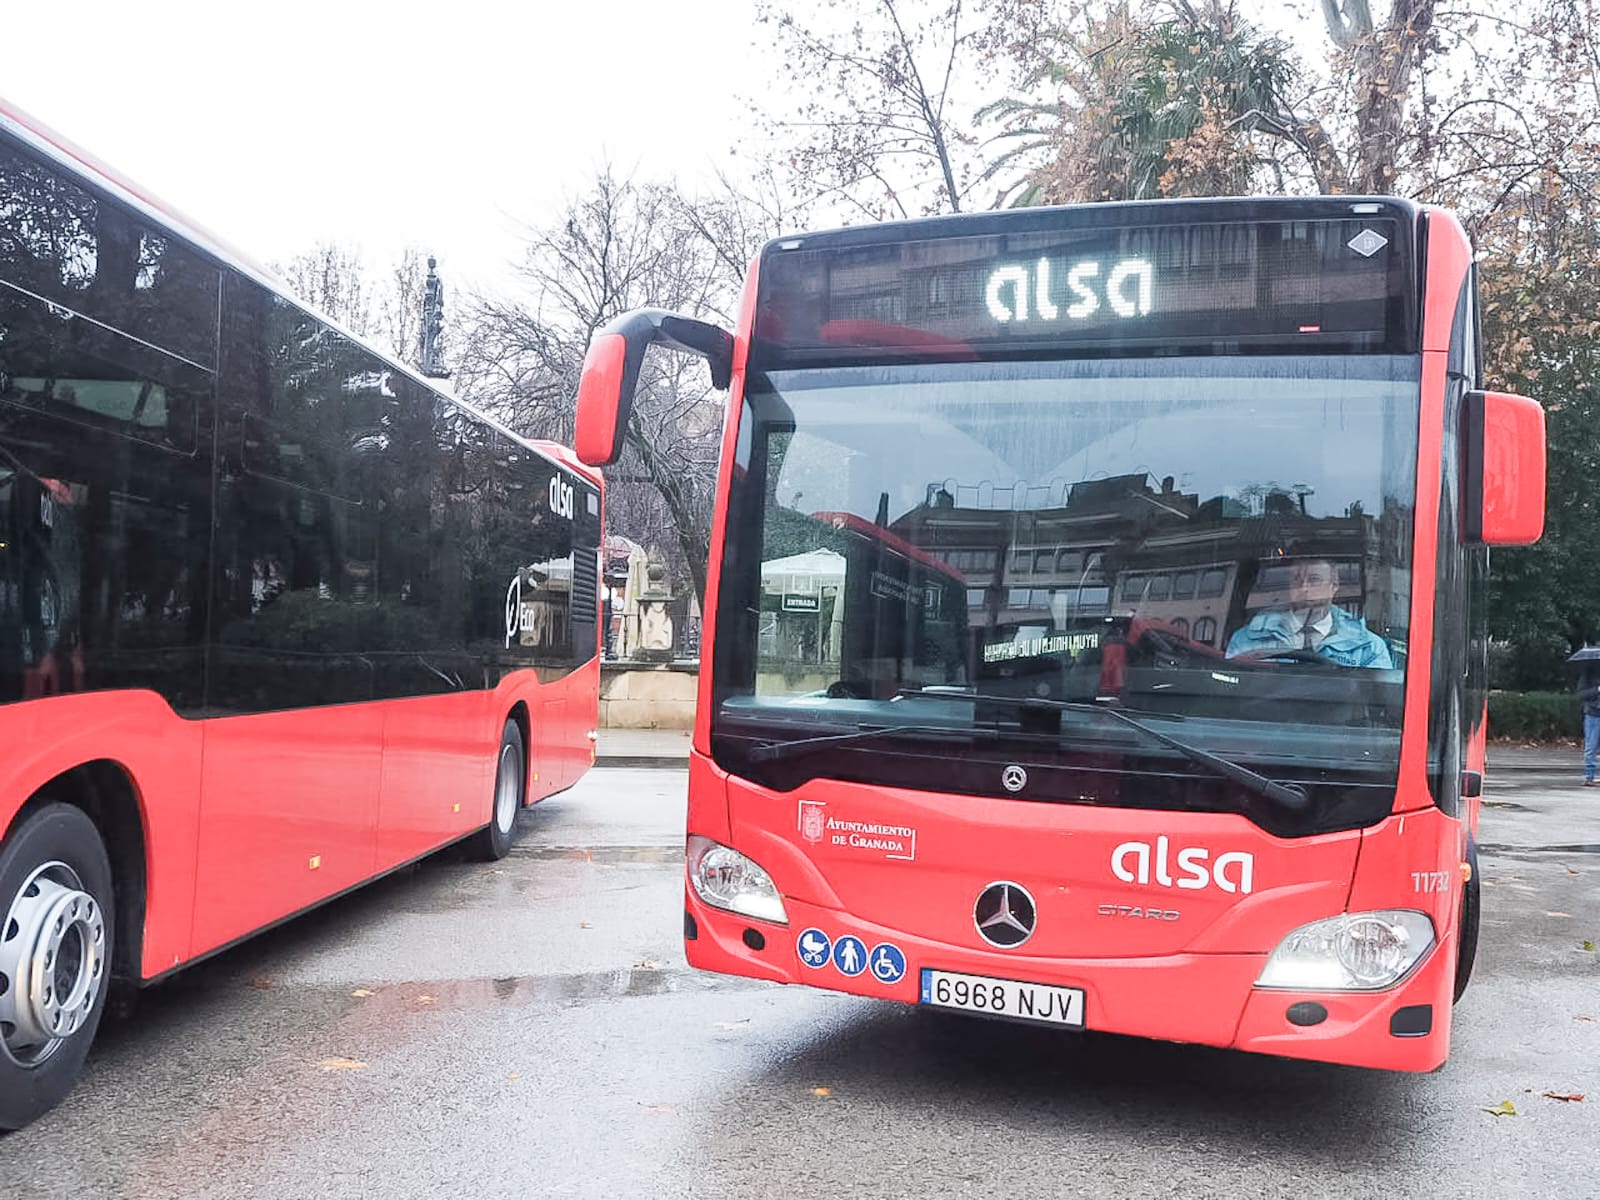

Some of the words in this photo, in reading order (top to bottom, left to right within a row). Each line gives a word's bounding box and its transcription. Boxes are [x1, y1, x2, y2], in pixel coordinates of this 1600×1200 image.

[986, 257, 1152, 321] alsa
[550, 472, 573, 520] alsa
[520, 602, 534, 631] Eco
[787, 599, 816, 608] ENTRADA
[1111, 835, 1253, 894] alsa
[1098, 904, 1180, 921] CITARO
[937, 978, 1006, 1010] 6968
[1018, 988, 1072, 1020] NJV
